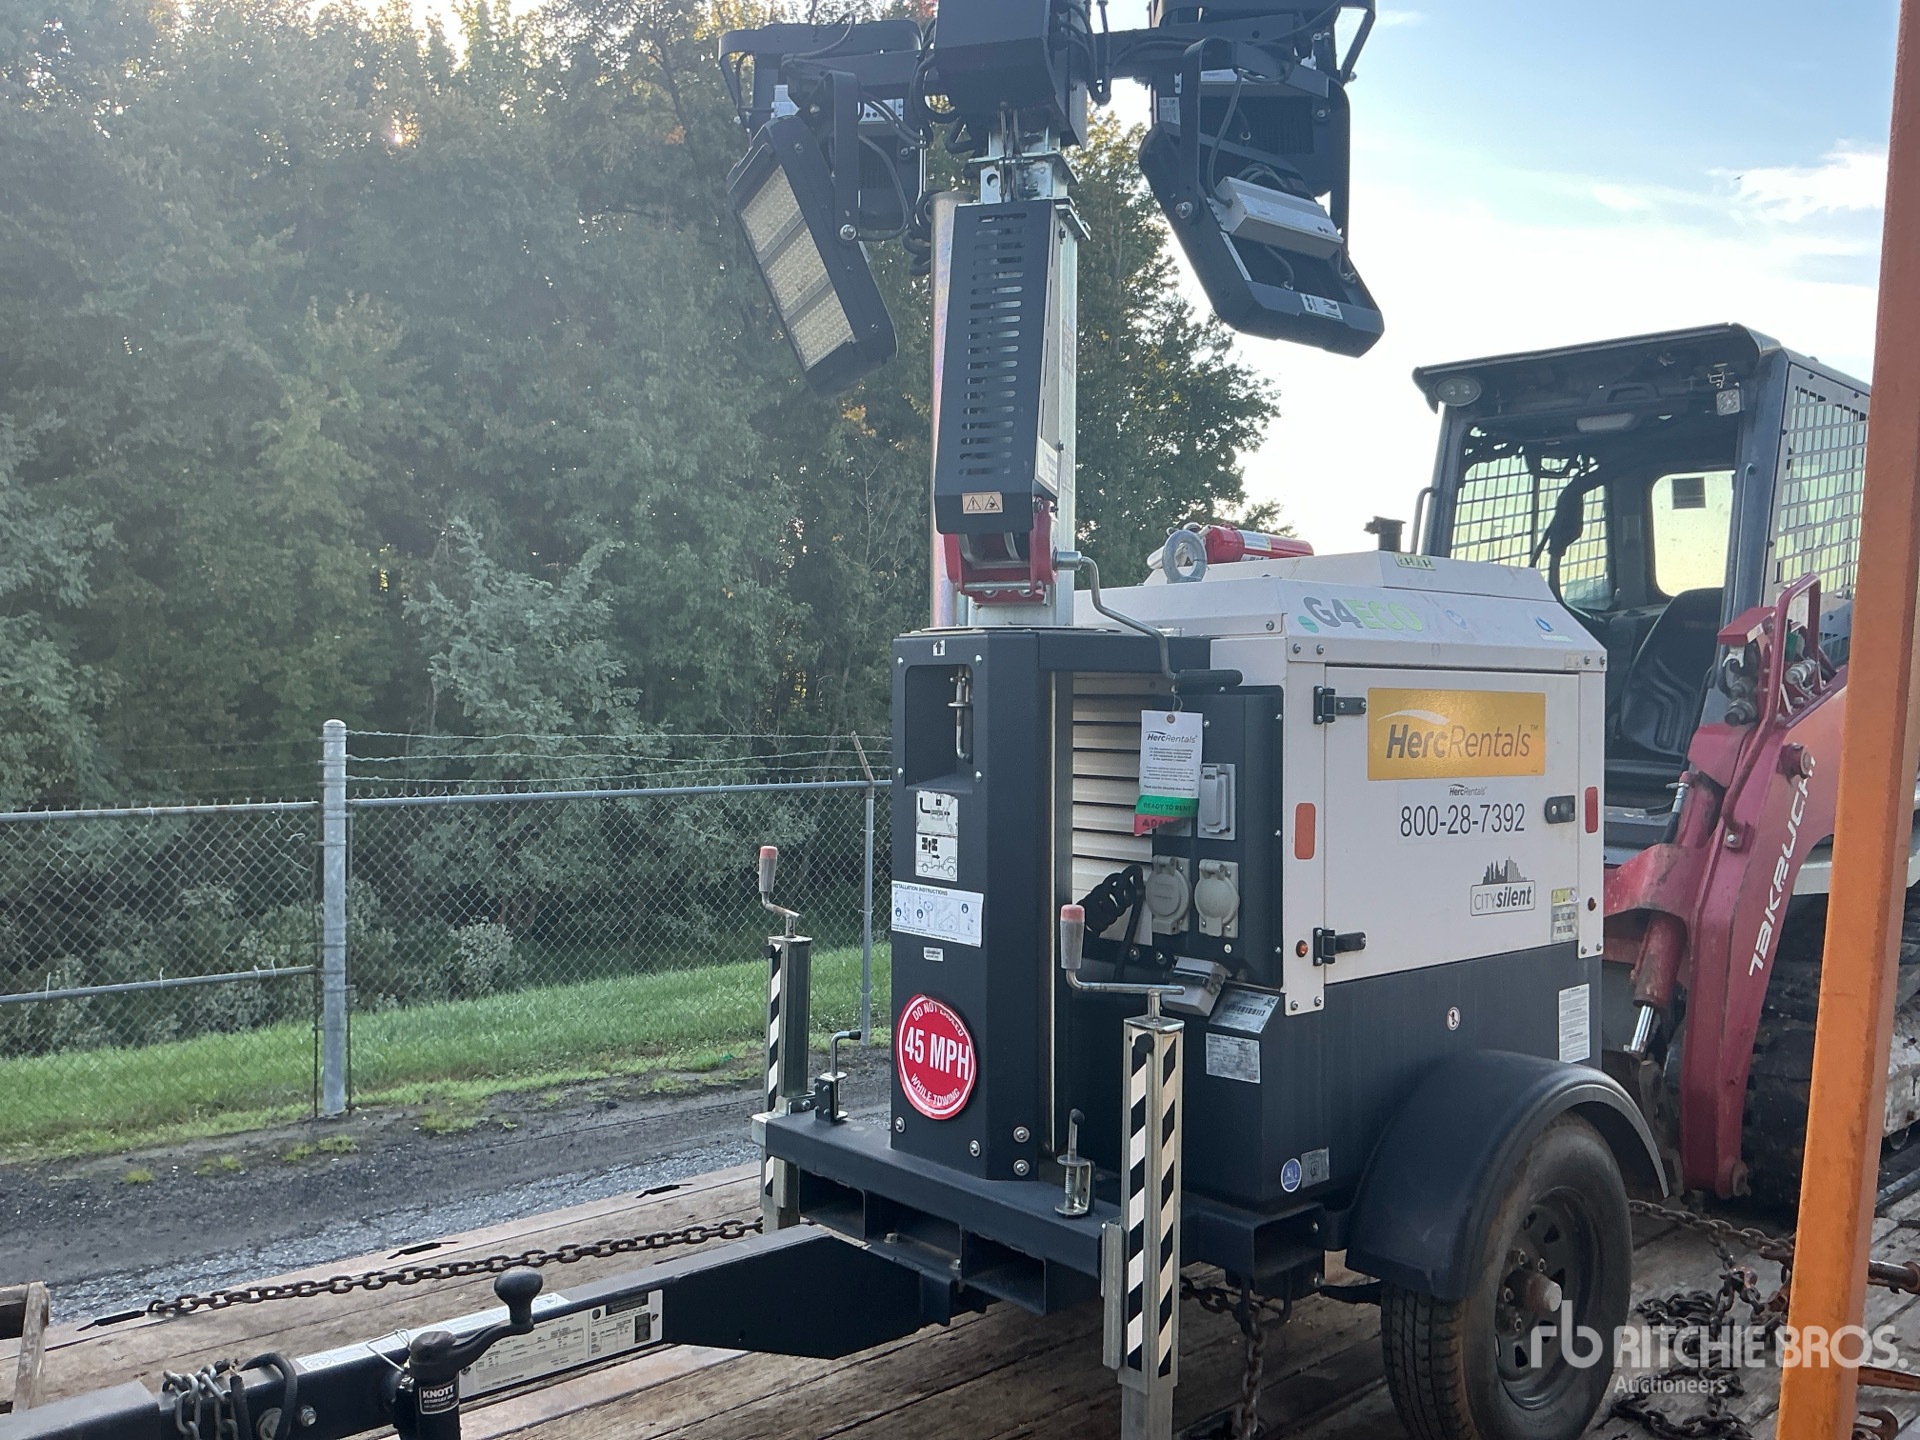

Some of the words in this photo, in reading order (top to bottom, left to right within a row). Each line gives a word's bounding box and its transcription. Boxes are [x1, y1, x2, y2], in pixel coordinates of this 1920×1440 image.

[1386, 723, 1531, 759] HercRentals
[1143, 802, 1164, 810] READY
[1400, 803, 1526, 837] 800-28-7392
[918, 886, 948, 896] INSTRUCTIONS
[1474, 885, 1533, 911] CITYsilent
[912, 1006, 922, 1021] DO
[923, 1002, 938, 1015] NOT
[904, 1026, 925, 1064] 45
[929, 1033, 970, 1080] MPH
[910, 1073, 932, 1100] WHILE
[932, 1087, 961, 1106] TOWING
[422, 1384, 454, 1399] KNOTT
